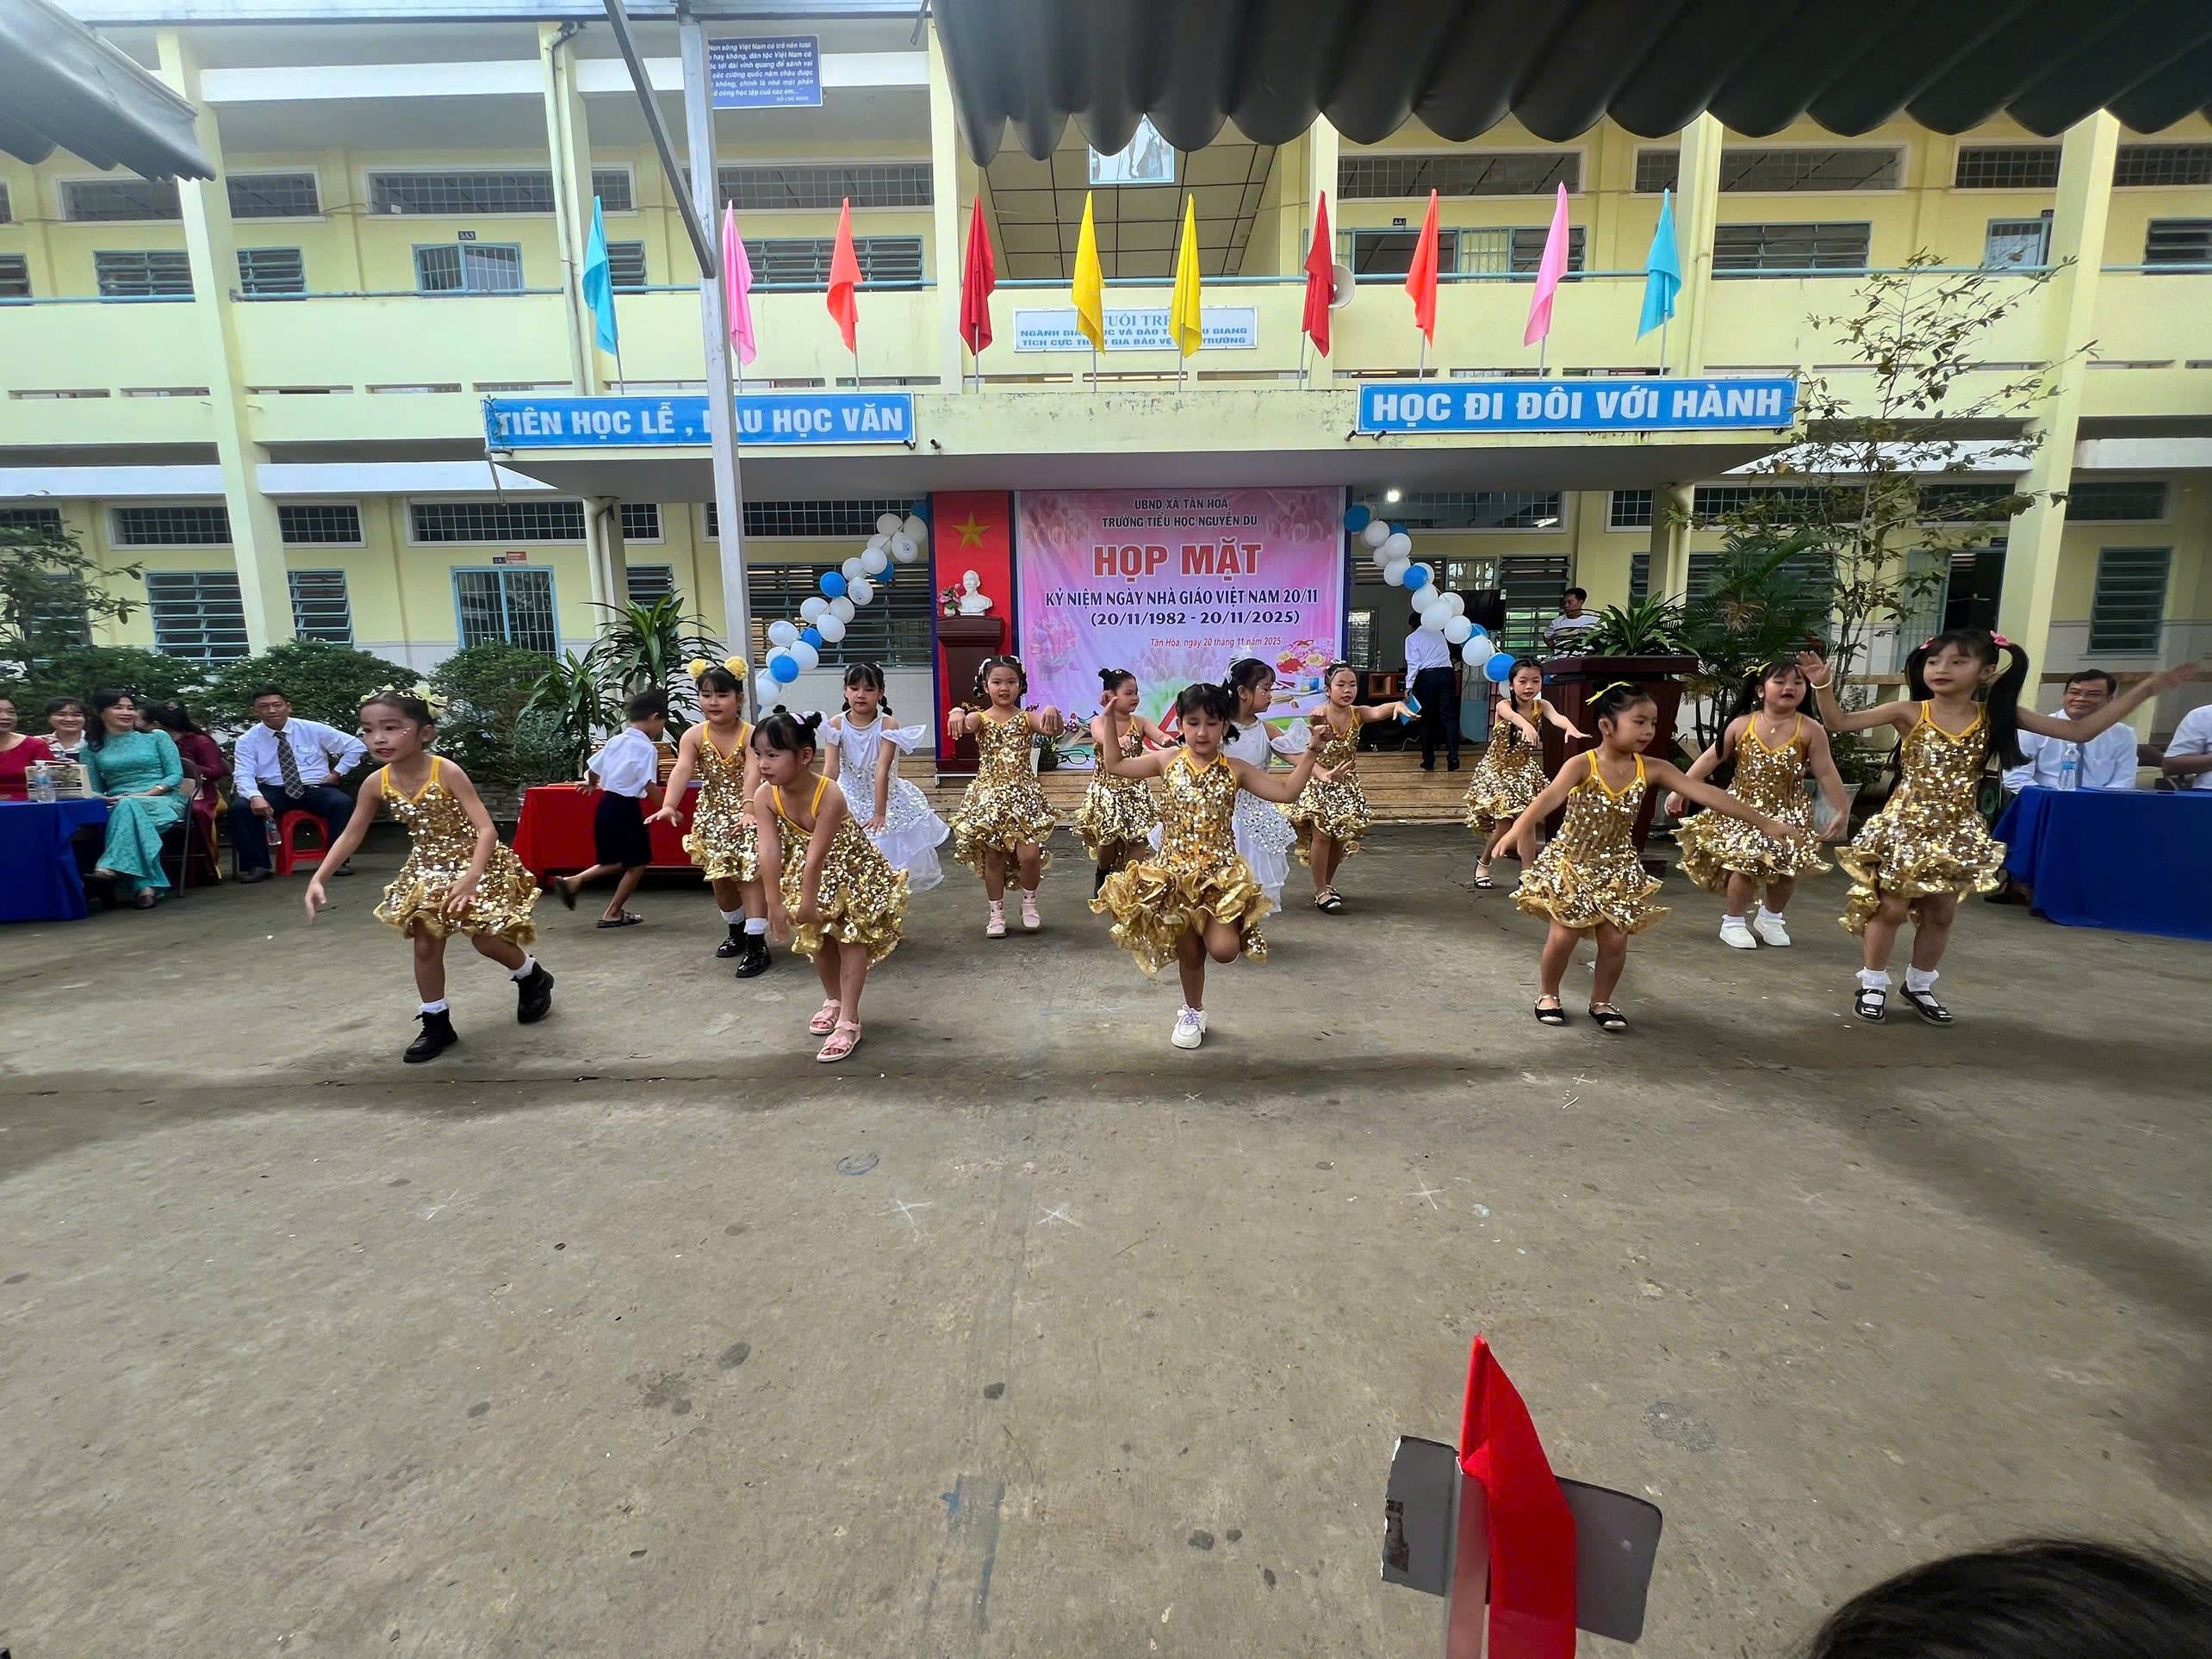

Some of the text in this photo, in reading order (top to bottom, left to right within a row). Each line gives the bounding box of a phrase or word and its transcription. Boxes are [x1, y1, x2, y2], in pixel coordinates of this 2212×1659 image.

[1373, 384, 1782, 427] HỌC ĐI ĐÔI VỚI HÀNH
[496, 407, 563, 435] TIÊN
[571, 410, 631, 439] HỌC
[641, 401, 674, 434] LỄ
[772, 407, 833, 438] HỌC
[842, 402, 903, 432] VĂN
[1134, 500, 1162, 510] UBND
[1166, 497, 1179, 510] XÃ
[1184, 497, 1203, 509] TÂN
[1102, 511, 1258, 528] TRƯỜNG TIỂU HỌC NGUYỄN DU
[1095, 537, 1261, 582] HỌP MẶT
[1046, 586, 1318, 610] KỶ NIỆM NGÀY NHÀ GIÁO VIỆT NAM 20/11
[1091, 612, 1186, 627] (20/11/1982
[1200, 610, 1300, 625] 20/11/2025)
[1203, 637, 1213, 646] 20
[1237, 637, 1245, 646] 11
[1264, 637, 1282, 646] 2025
